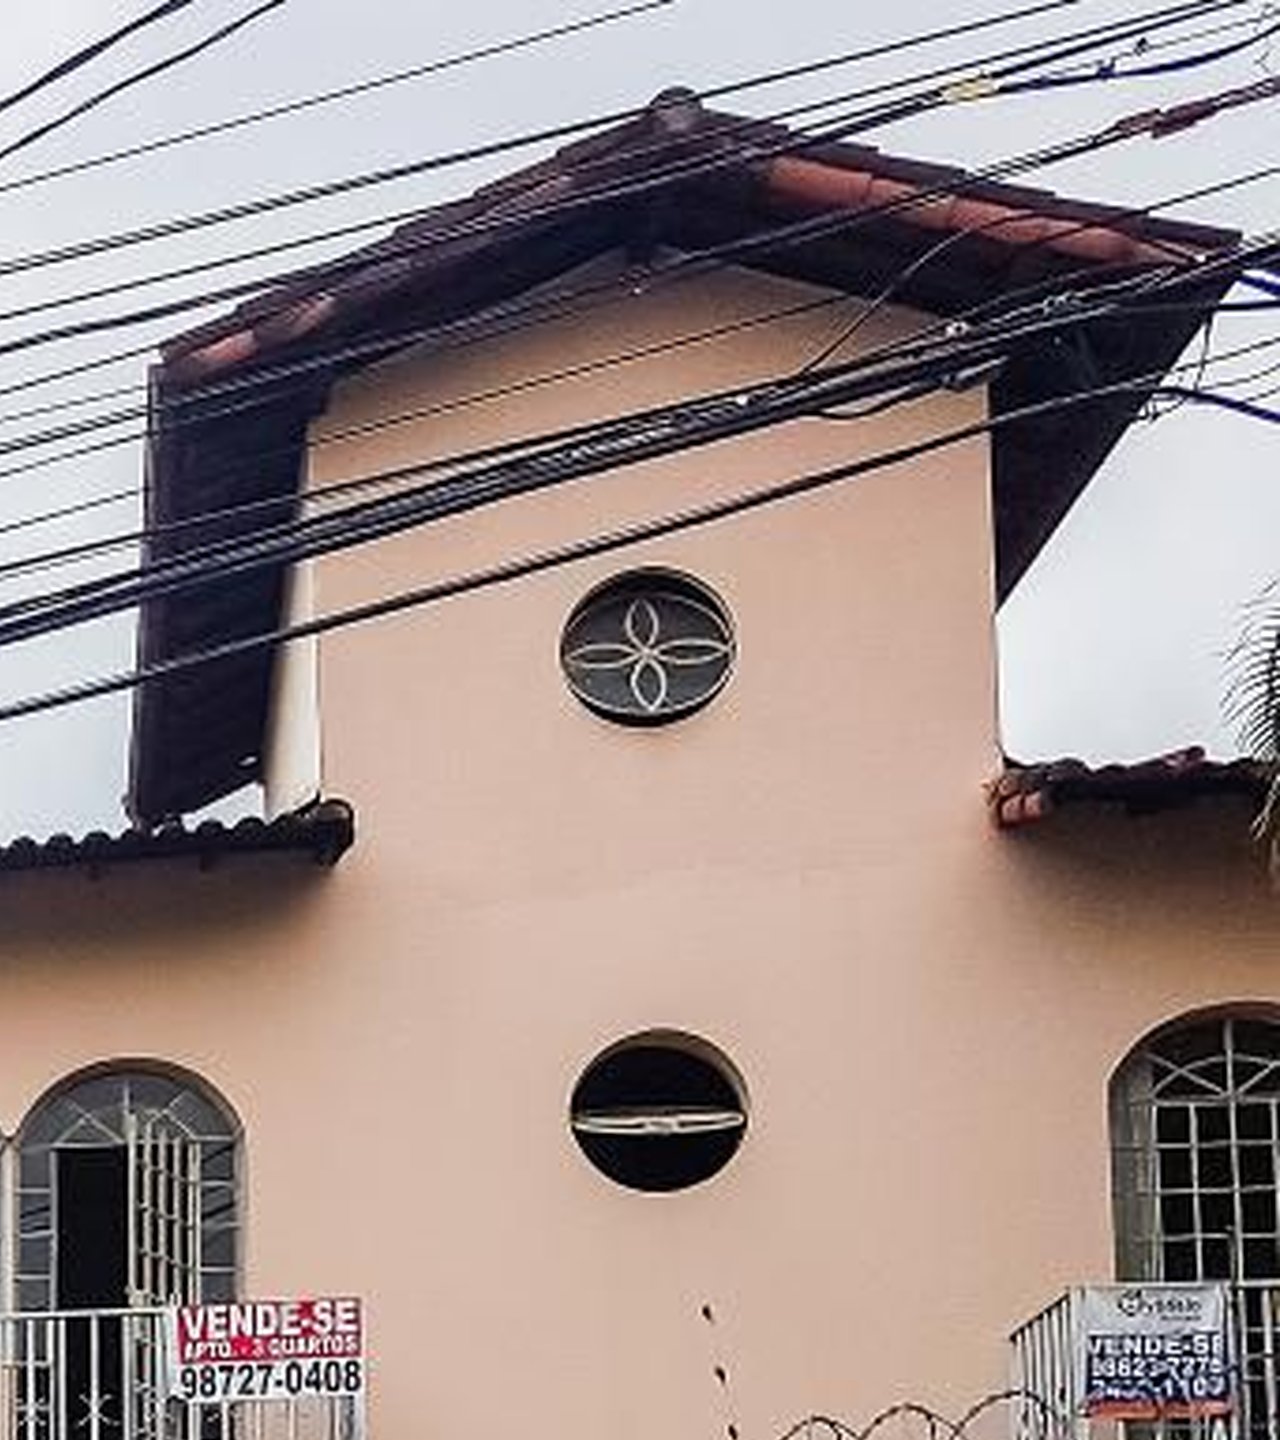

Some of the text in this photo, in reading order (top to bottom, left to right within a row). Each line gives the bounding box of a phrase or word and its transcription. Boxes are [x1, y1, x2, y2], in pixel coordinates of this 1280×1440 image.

[181, 1300, 359, 1340] VENDE-SE
[269, 1334, 358, 1357] QUARTOS
[180, 1360, 362, 1399] 98727-0408
